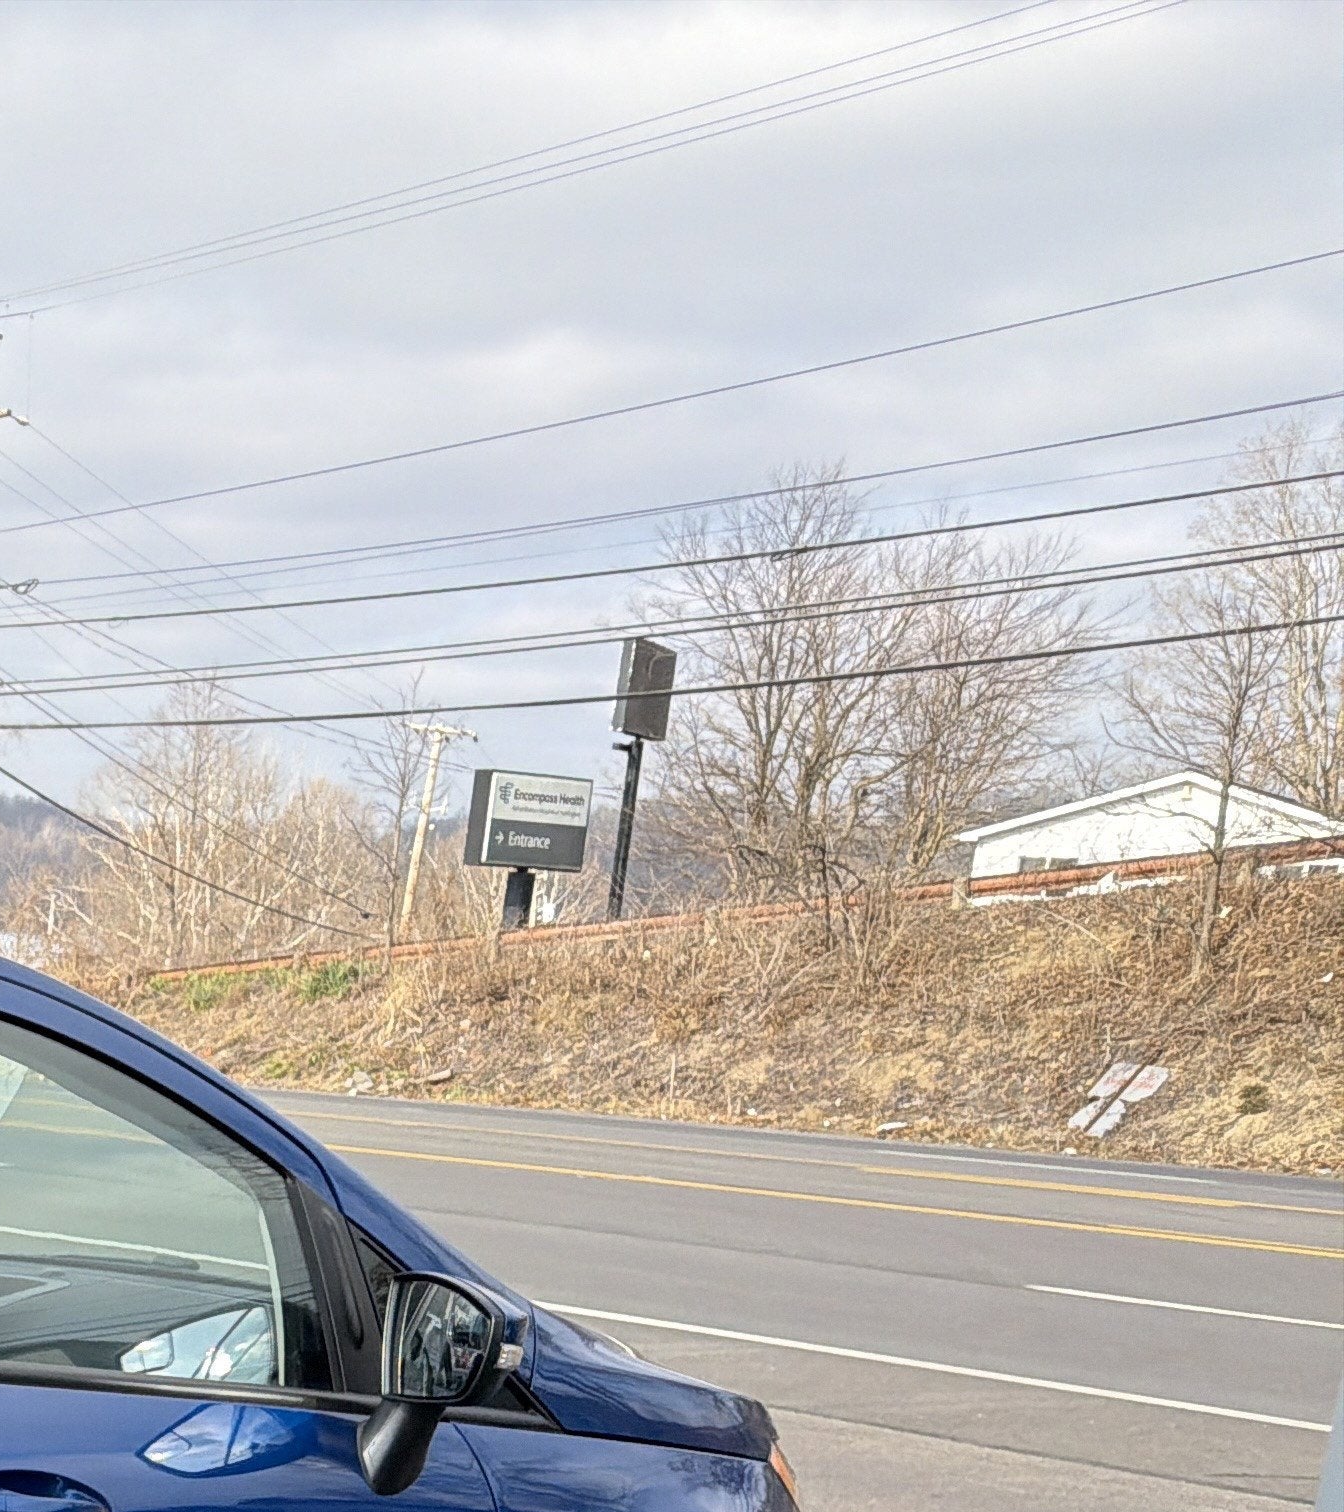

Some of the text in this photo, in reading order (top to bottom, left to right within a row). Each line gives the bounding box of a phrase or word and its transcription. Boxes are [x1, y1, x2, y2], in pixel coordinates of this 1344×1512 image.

[514, 788, 585, 806] Encompass Health
[508, 831, 550, 849] Entrance
